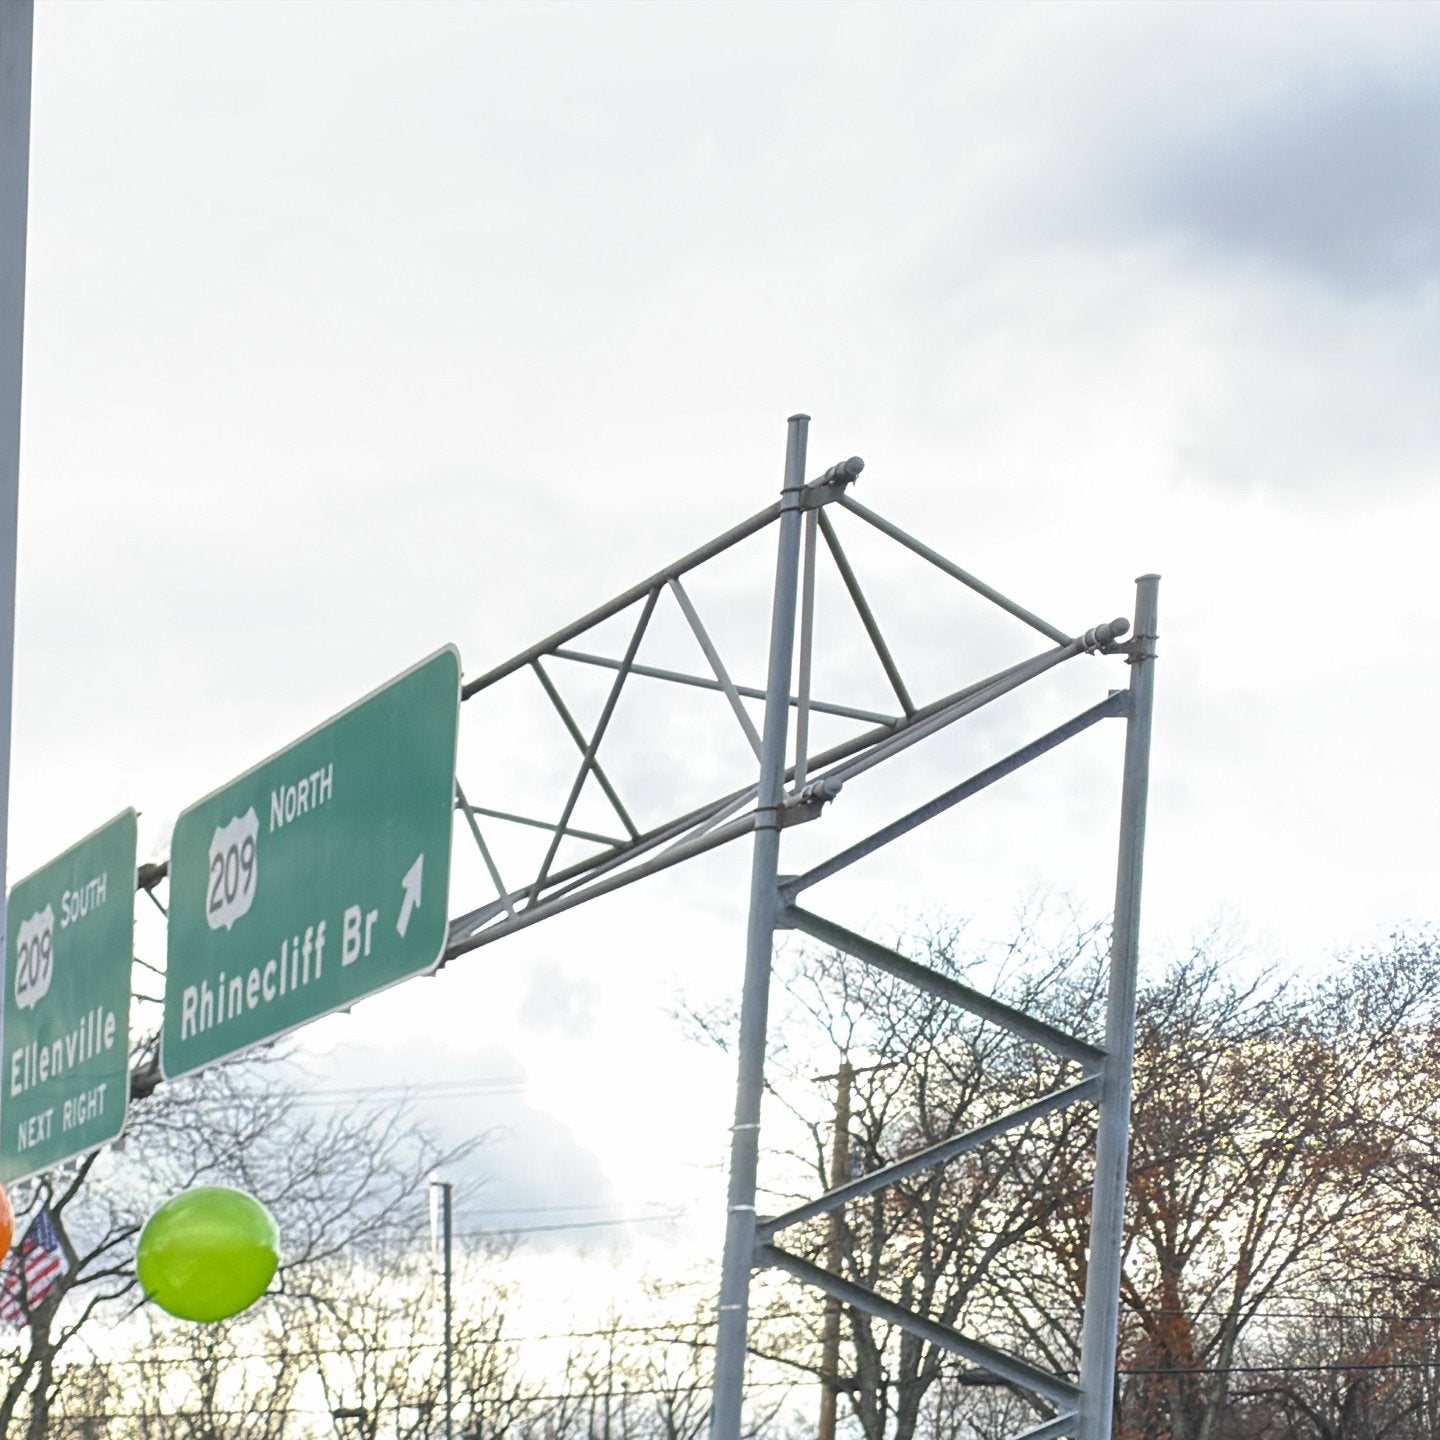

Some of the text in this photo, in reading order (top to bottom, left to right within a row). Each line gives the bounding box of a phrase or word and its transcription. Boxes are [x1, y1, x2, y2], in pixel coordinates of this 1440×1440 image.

[270, 763, 334, 833] NORTH
[60, 872, 107, 929] SOUTH
[209, 835, 255, 915] 209
[16, 929, 51, 995] 209
[181, 904, 379, 1041] Rhinecliff Br
[10, 1005, 116, 1098] Ellenville
[17, 1083, 108, 1153] NEXT RIGHT
